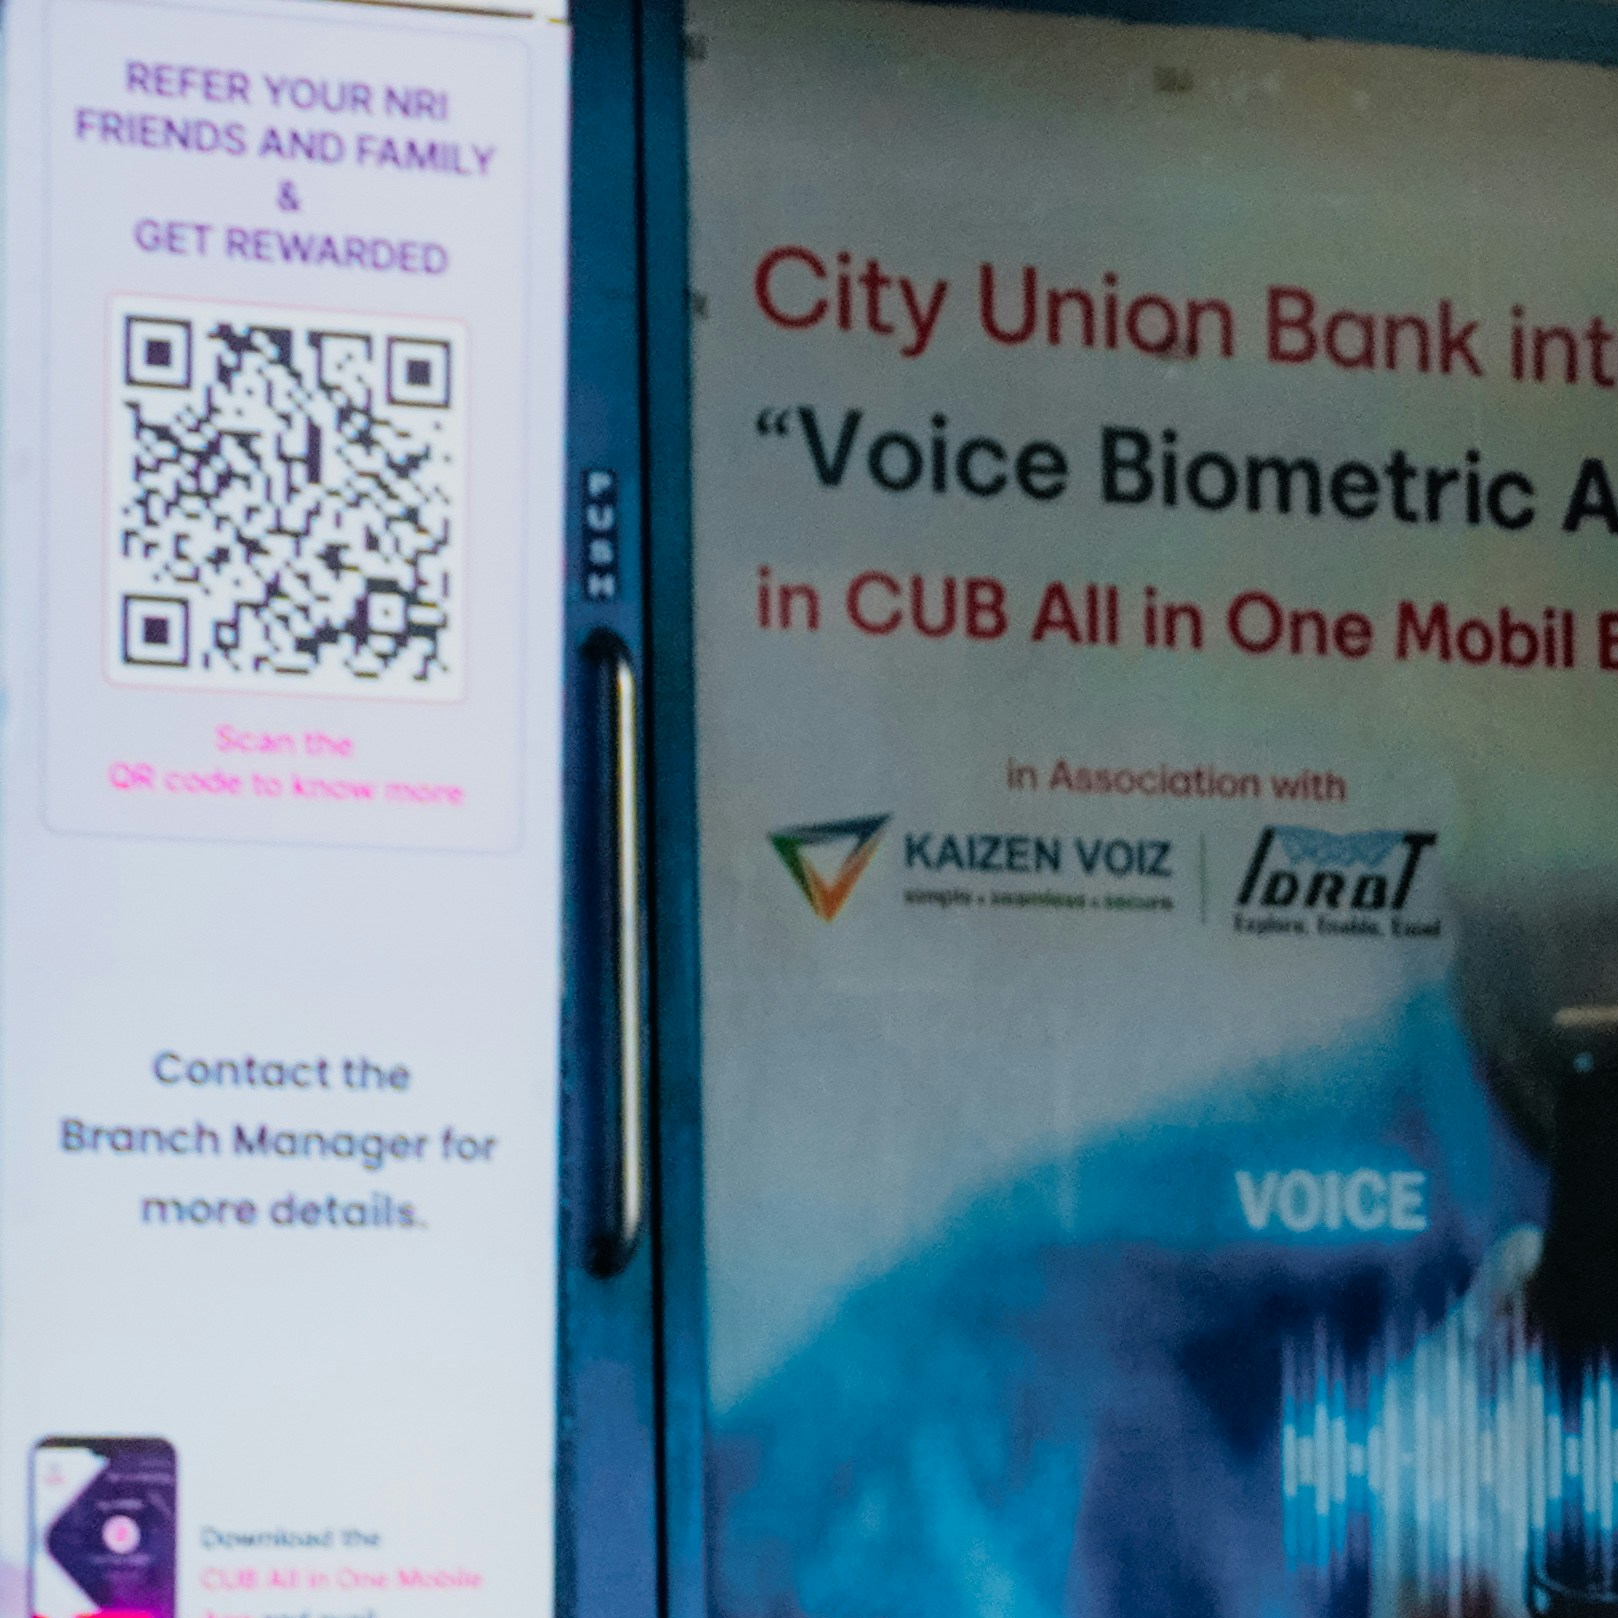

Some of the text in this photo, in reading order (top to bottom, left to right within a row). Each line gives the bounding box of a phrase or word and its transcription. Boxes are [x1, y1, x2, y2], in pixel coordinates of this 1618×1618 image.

[126, 62, 447, 121] REFER YOUR NRI
[76, 109, 496, 176] FRIENDS AND FAMILY
[278, 181, 301, 212] &
[136, 220, 448, 274] GET REWARDED
[754, 245, 949, 358] City
[980, 261, 1234, 359] Union
[1267, 284, 1484, 378] Bank
[755, 406, 1070, 500] “Voice
[1101, 424, 1536, 530] Biometric
[584, 470, 616, 598] PUSH
[756, 566, 820, 631] in
[845, 571, 1009, 641] CUB
[1031, 581, 1119, 646] All
[1144, 586, 1204, 650] in
[1227, 591, 1374, 659] One
[1397, 600, 1575, 669] Mobil
[215, 726, 354, 758] Scan the
[109, 765, 464, 806] QR code to know more
[1007, 758, 1346, 801] in Association with
[905, 832, 1173, 878] KAIZEN VOIZ
[154, 1051, 410, 1091] Contact the
[60, 1117, 496, 1170] Branch Manager for
[142, 1194, 428, 1229] more details.
[1235, 1168, 1426, 1234] VOICE
[201, 1526, 380, 1550] Download the
[200, 1567, 256, 1591] CUB
[337, 1567, 388, 1590] One
[396, 1567, 484, 1590] Mobile
